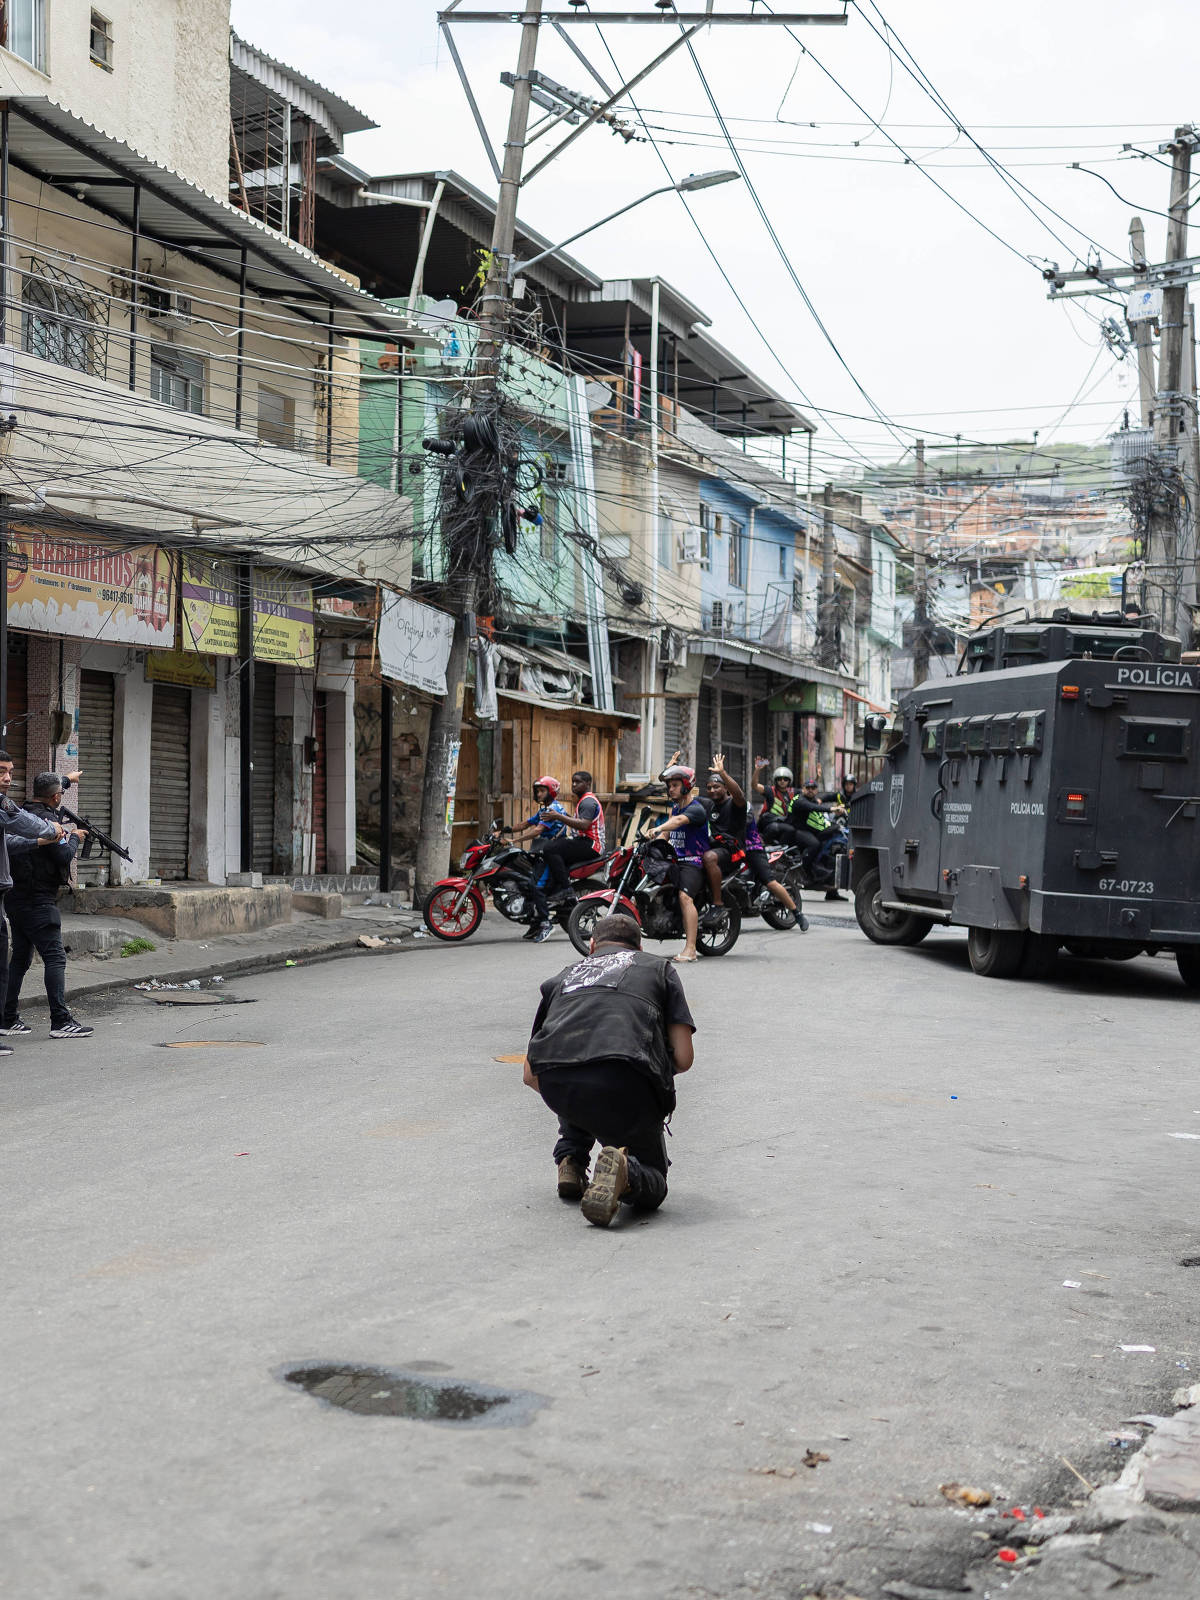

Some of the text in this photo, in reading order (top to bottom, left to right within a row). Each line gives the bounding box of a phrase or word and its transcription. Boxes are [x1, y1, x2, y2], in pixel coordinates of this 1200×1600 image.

[1117, 666, 1193, 687] POLÍCIA
[1010, 800, 1045, 816] POLÍCIA CIVIL
[1098, 878, 1154, 894] 67-0723
